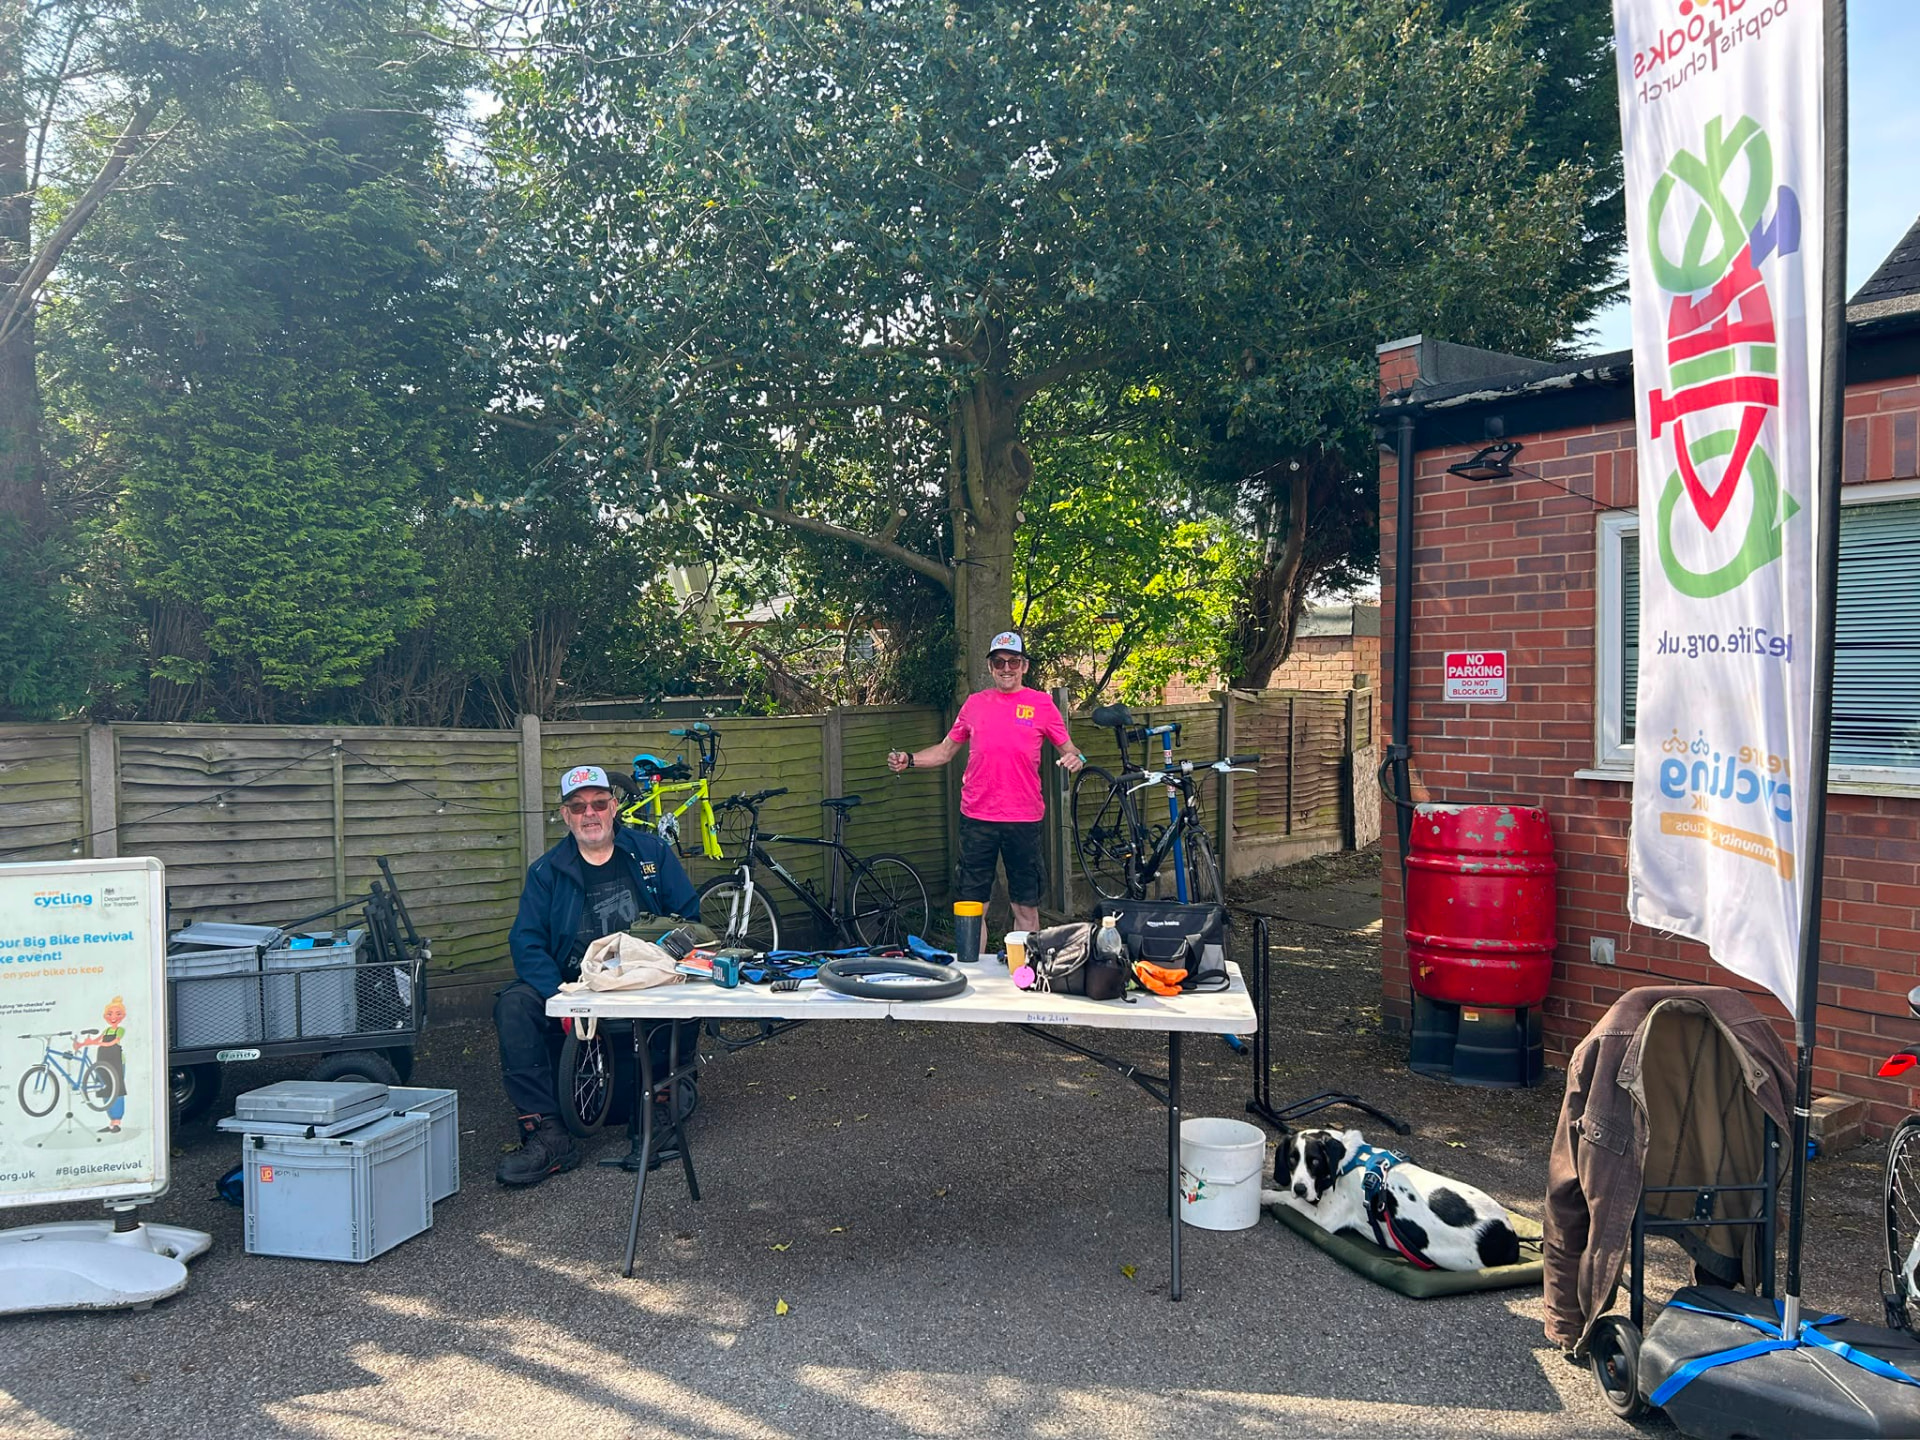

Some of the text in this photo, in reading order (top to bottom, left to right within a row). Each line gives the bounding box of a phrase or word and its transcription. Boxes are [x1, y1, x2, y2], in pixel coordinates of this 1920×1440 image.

[1466, 654, 1485, 665] NO
[1448, 665, 1503, 677] PARKING
[34, 893, 93, 908] cycling
[23, 936, 46, 948] Big
[49, 934, 80, 946] Bike
[83, 931, 134, 943] Revival
[17, 951, 62, 963] event!
[18, 970, 41, 980] your
[42, 967, 65, 977] bike
[80, 966, 104, 975] keep
[0, 1160, 143, 1181] org.uk #BigBikeRevival
